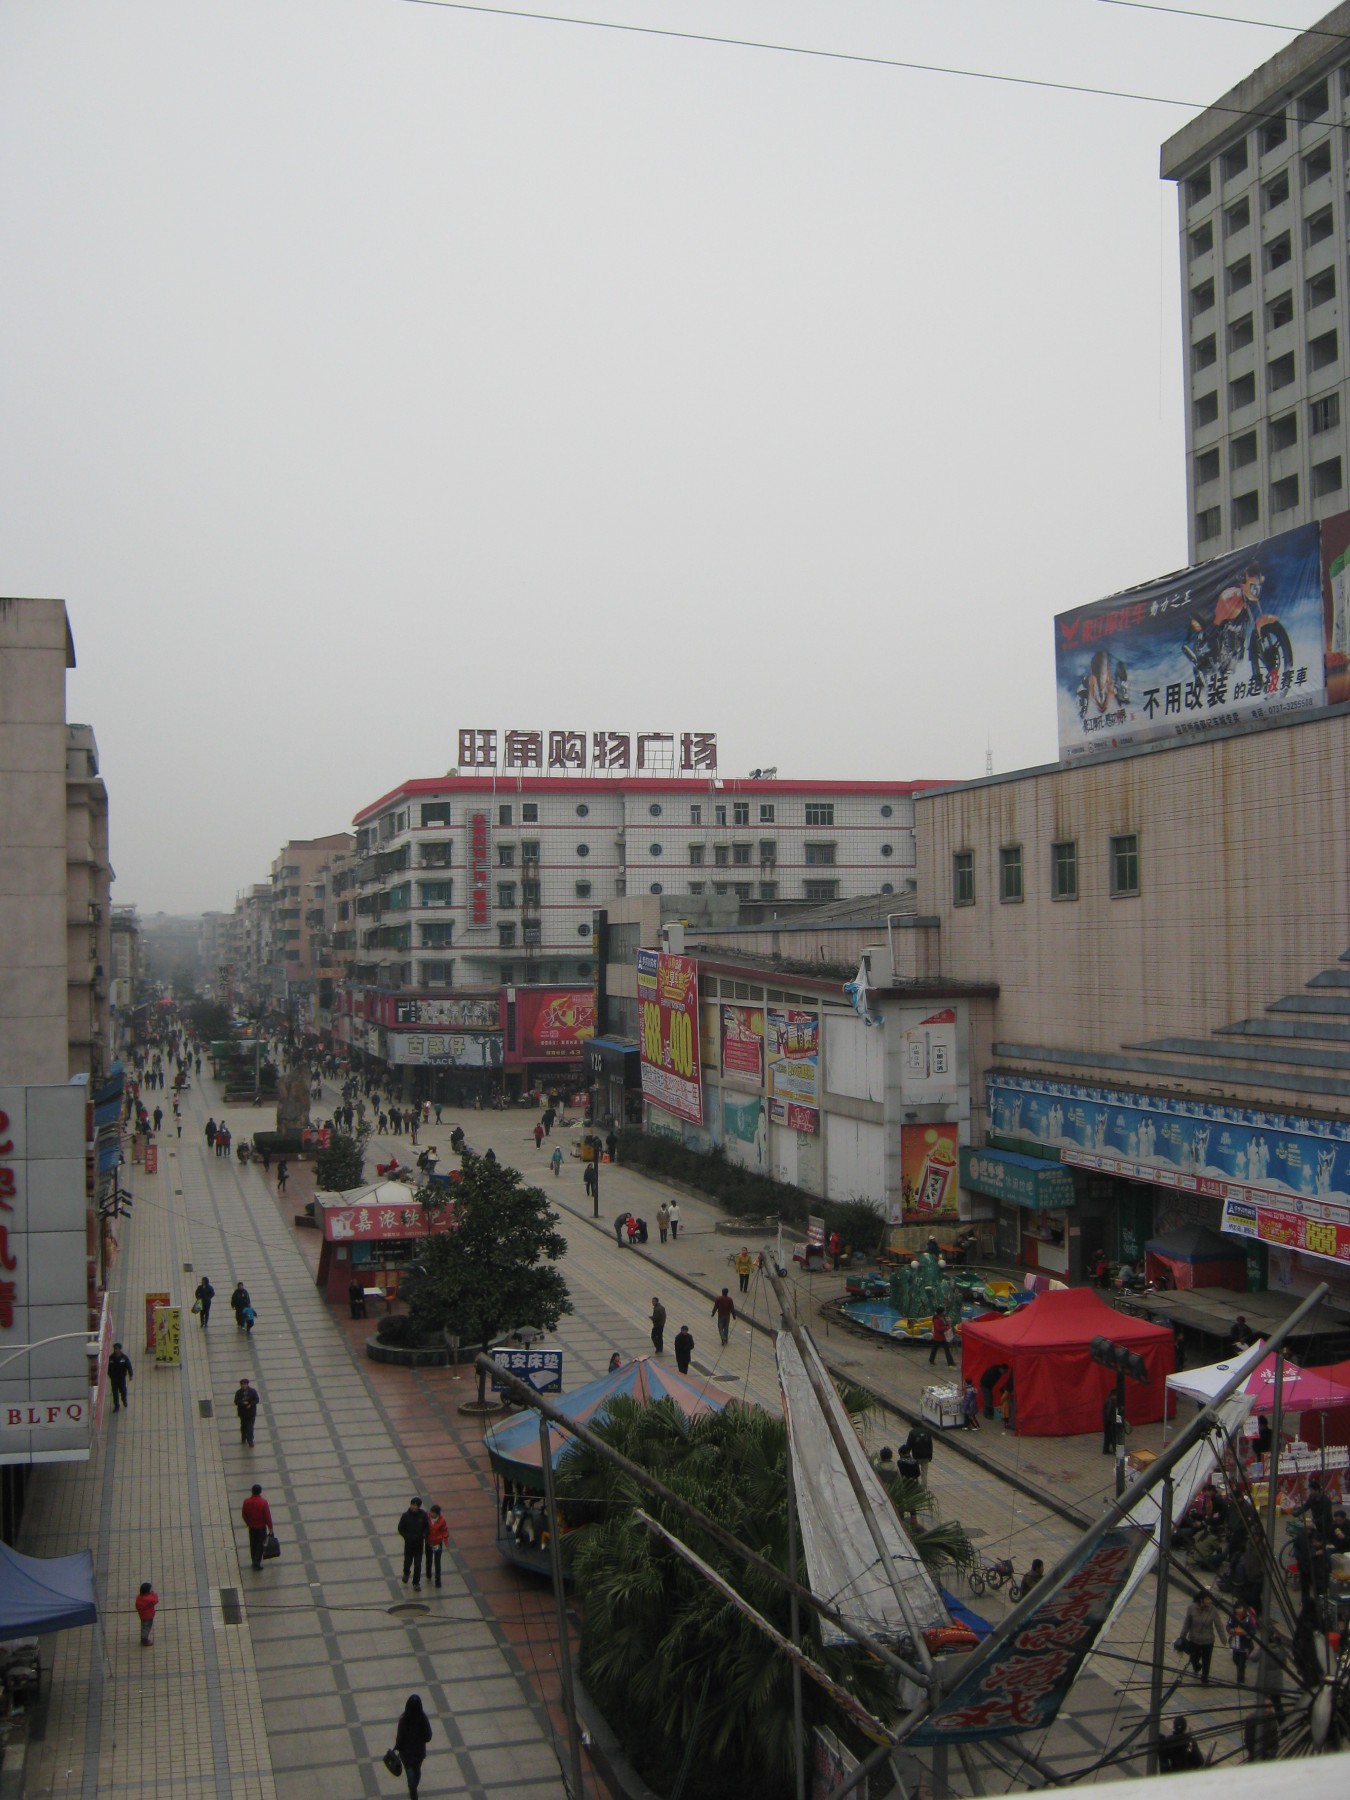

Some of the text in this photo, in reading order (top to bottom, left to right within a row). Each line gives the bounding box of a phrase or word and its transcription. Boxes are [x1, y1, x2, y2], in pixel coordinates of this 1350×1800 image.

[458, 729, 717, 770] 旺角购物广场
[494, 1353, 559, 1368] 晚安床垫
[7, 1404, 82, 1425] BLFQ
